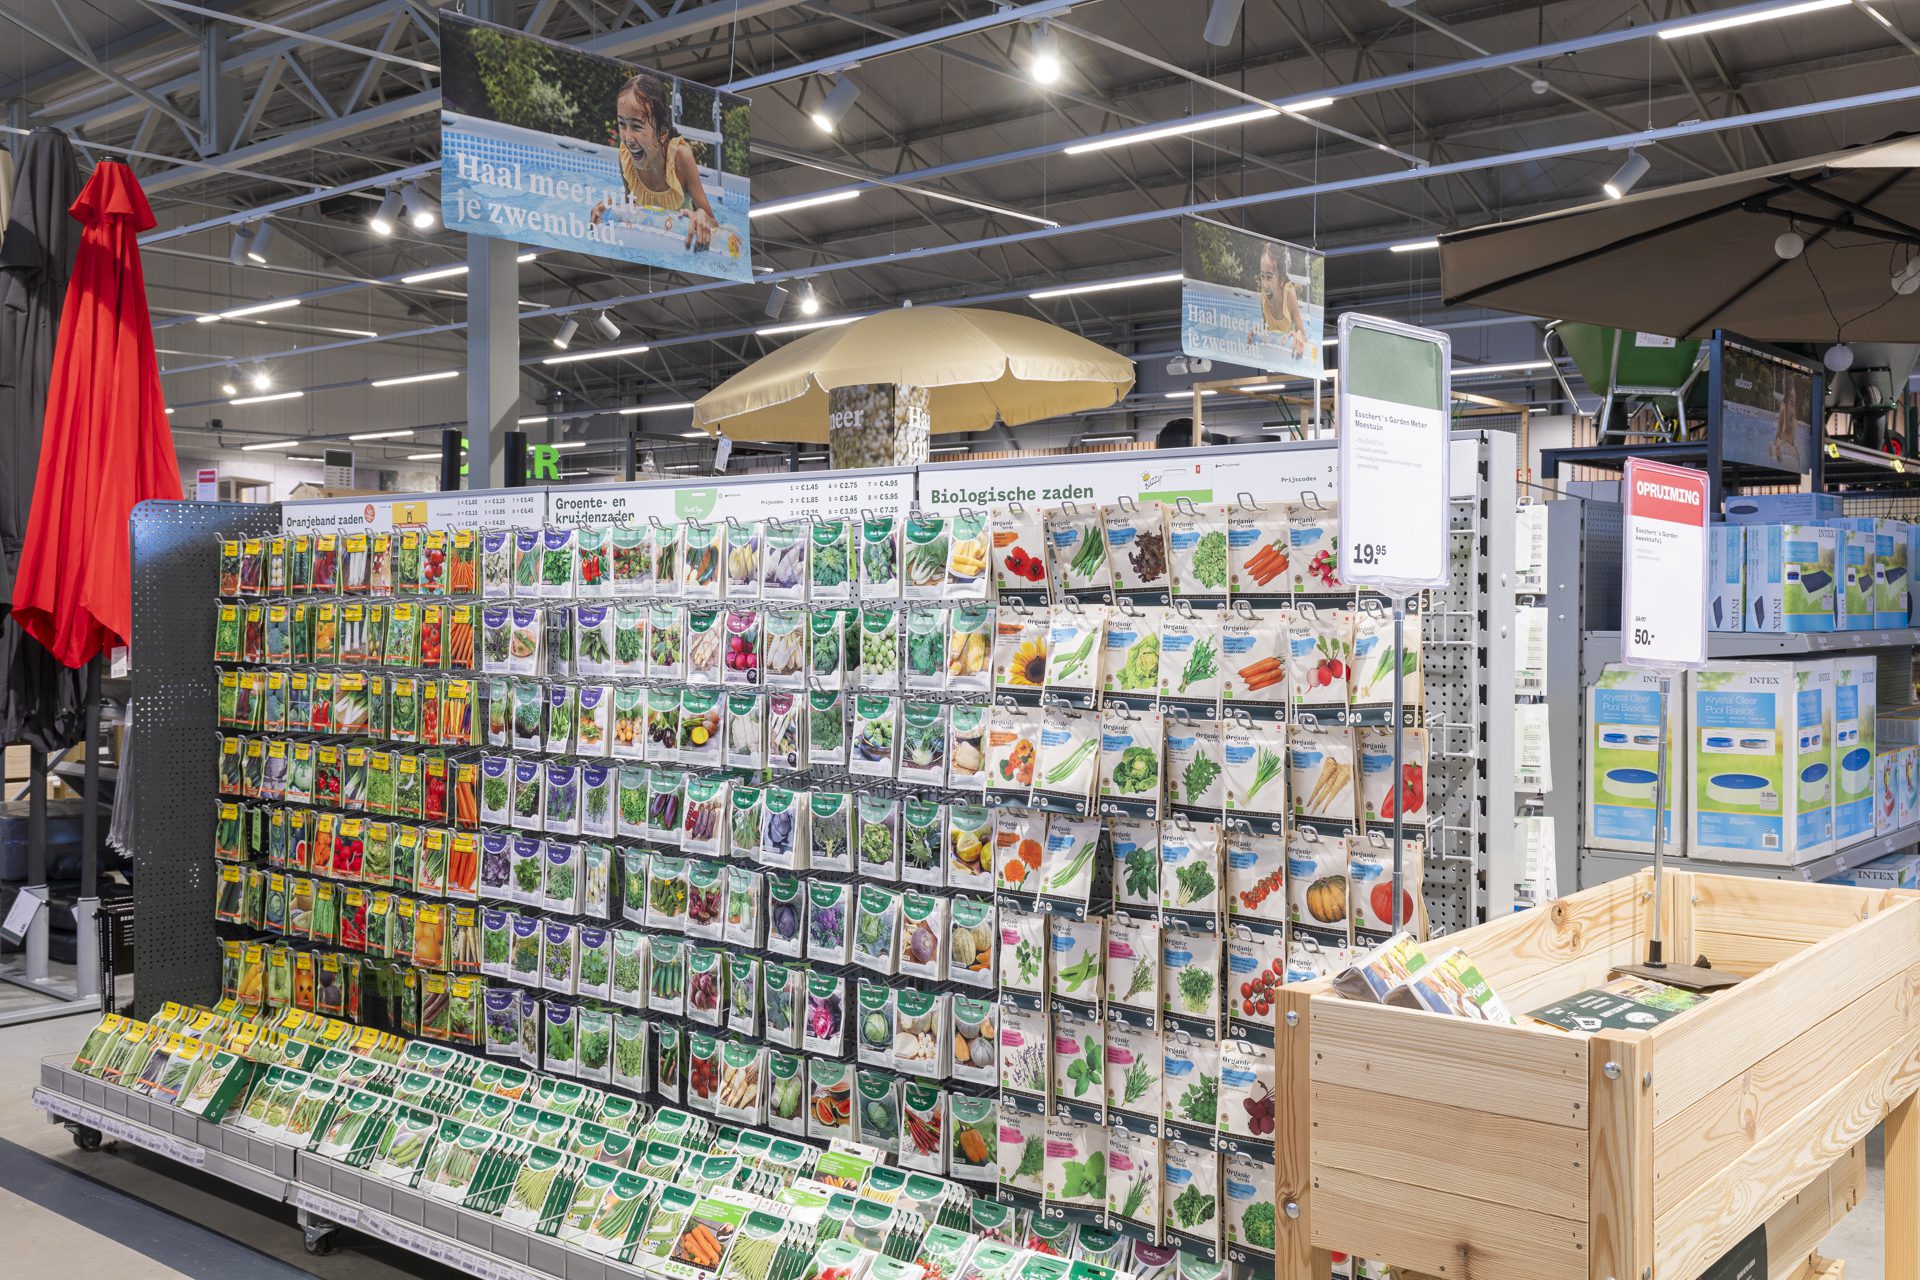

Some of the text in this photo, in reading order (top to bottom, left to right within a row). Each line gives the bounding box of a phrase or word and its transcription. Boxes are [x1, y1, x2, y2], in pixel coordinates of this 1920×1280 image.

[457, 152, 636, 215] Haal meer uit
[456, 189, 625, 247] je zwembad.
[1188, 304, 1217, 326] Haal
[1220, 312, 1250, 332] meer
[1188, 328, 1200, 351] je
[1355, 420, 1384, 431] Moestuin
[1389, 416, 1410, 426] Garden
[1410, 420, 1428, 429] Meter
[1281, 476, 1317, 484] Prijscodes
[932, 484, 1094, 506] Biologische zaden
[1636, 480, 1700, 506] OPRUIMING
[556, 498, 626, 510] Groente- en
[287, 515, 364, 529] Oranjeband zaden
[1106, 517, 1130, 526] Organic
[1171, 520, 1196, 529] Organic
[1228, 518, 1255, 527] Organic
[1289, 517, 1317, 526] Organic
[1732, 598, 1740, 630] INTEX
[1108, 621, 1133, 629] Organic
[1163, 624, 1189, 633] Organic
[1223, 625, 1250, 634] Organic
[1750, 677, 1780, 685] INTEX
[1603, 694, 1651, 703] Krystal Clear
[1706, 696, 1758, 705] Krystal Clear
[1603, 703, 1620, 712] Pool
[1706, 706, 1724, 714] Pool
[1103, 724, 1128, 733] Organic
[1292, 739, 1317, 748] Organic
[1362, 743, 1388, 752] Organic
[1162, 835, 1186, 844] Organic
[1229, 840, 1253, 849] Organic
[1288, 846, 1312, 856] Organic
[1351, 851, 1377, 861] Organic
[1858, 871, 1895, 881] INTEX
[1164, 938, 1188, 948] Organic
[1230, 943, 1253, 953] Organic
[1108, 1035, 1130, 1046] Organic
[1164, 1046, 1188, 1057] Organic
[1222, 1056, 1251, 1068] Organic
[1047, 1130, 1073, 1140] Organic
[1227, 1168, 1251, 1179] Organic
